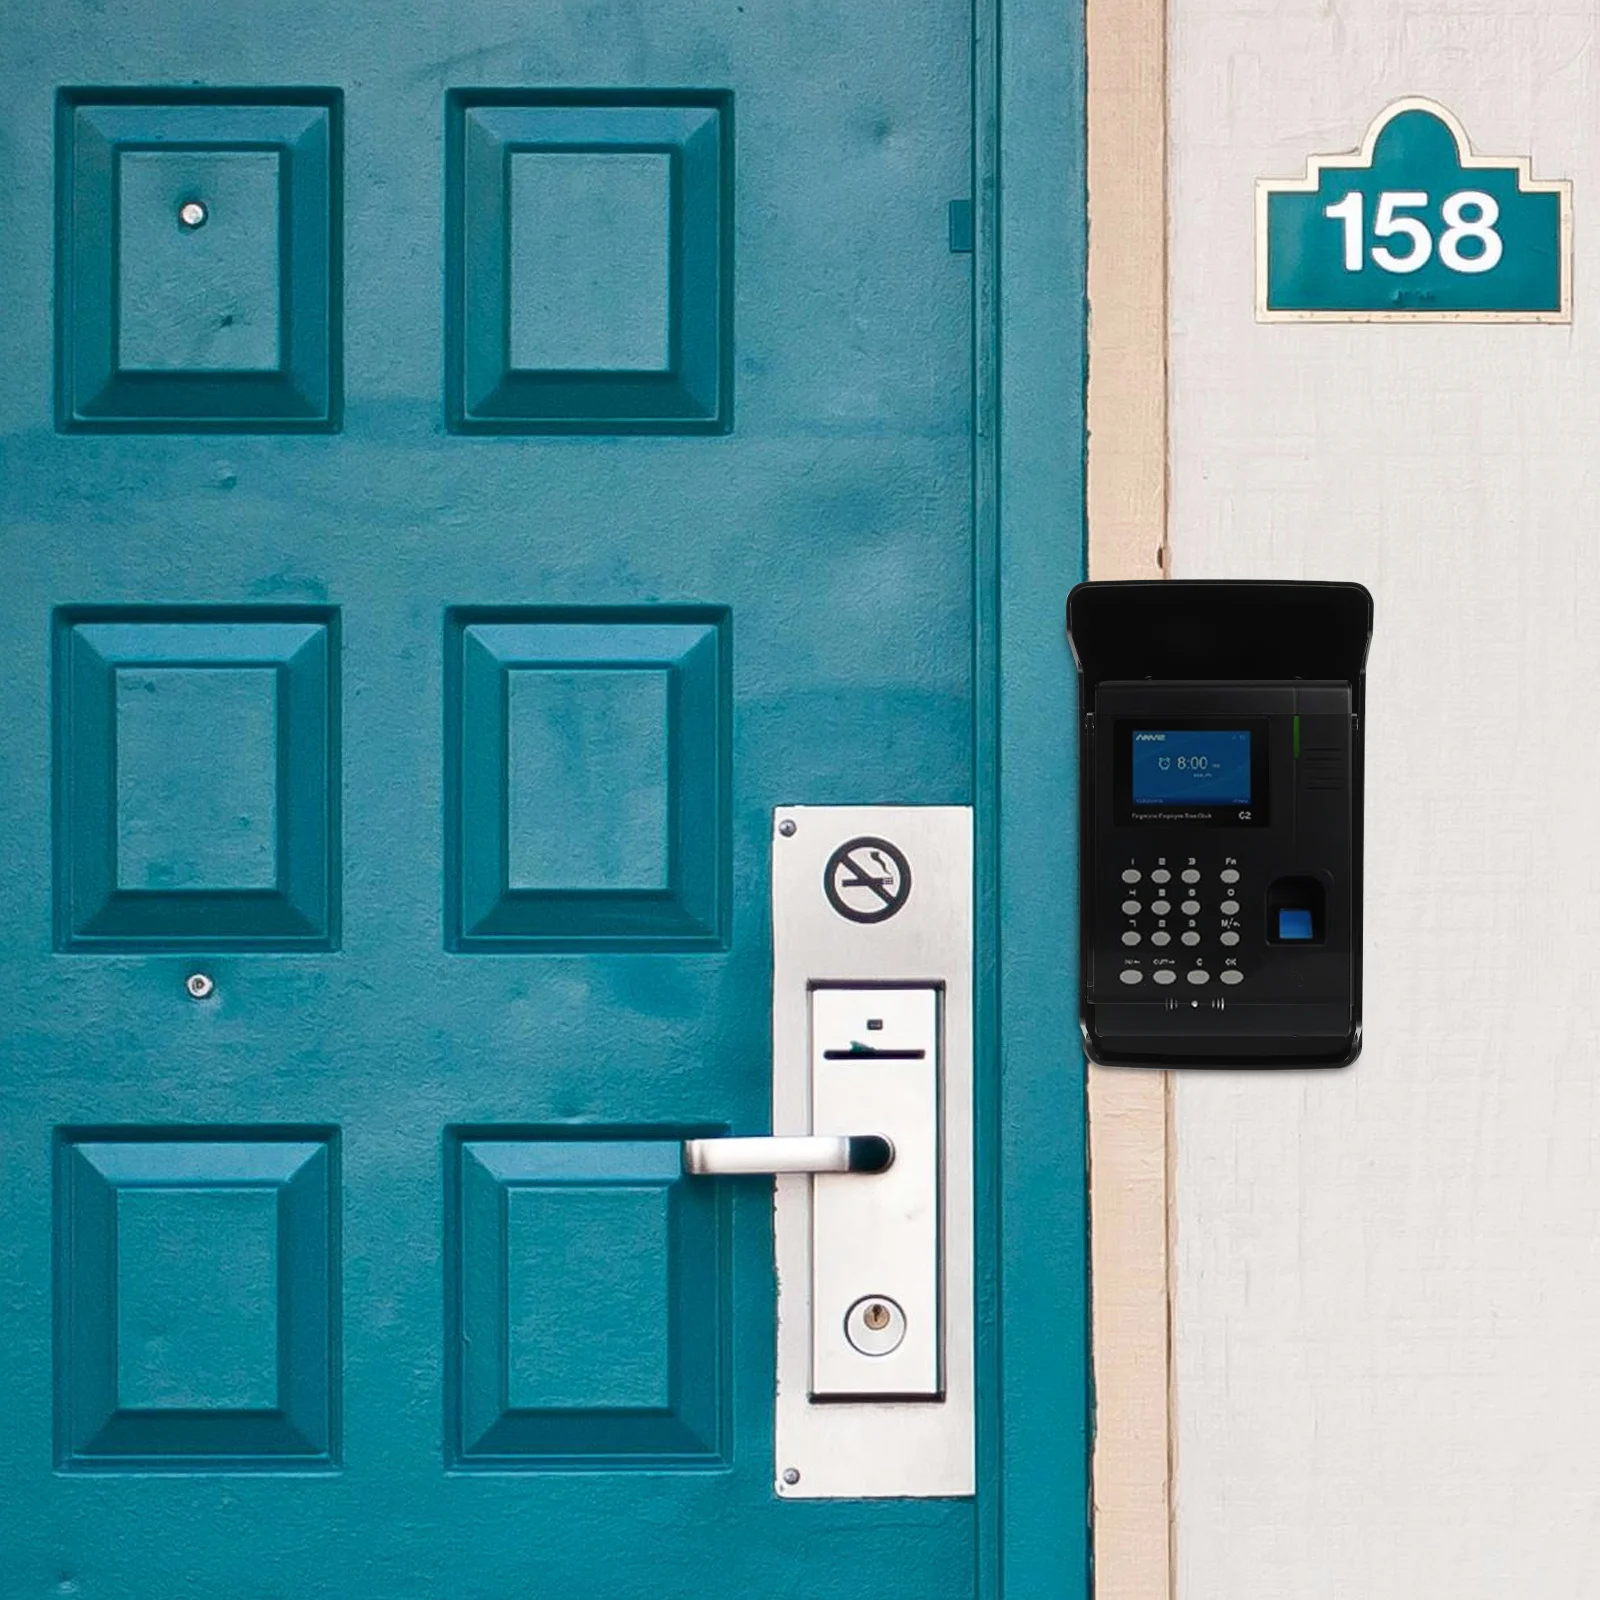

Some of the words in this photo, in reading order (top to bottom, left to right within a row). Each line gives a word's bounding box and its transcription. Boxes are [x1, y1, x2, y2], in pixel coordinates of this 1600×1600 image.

[1324, 190, 1504, 274] 158
[1177, 756, 1209, 770] 8:00
[1238, 811, 1252, 820] C2
